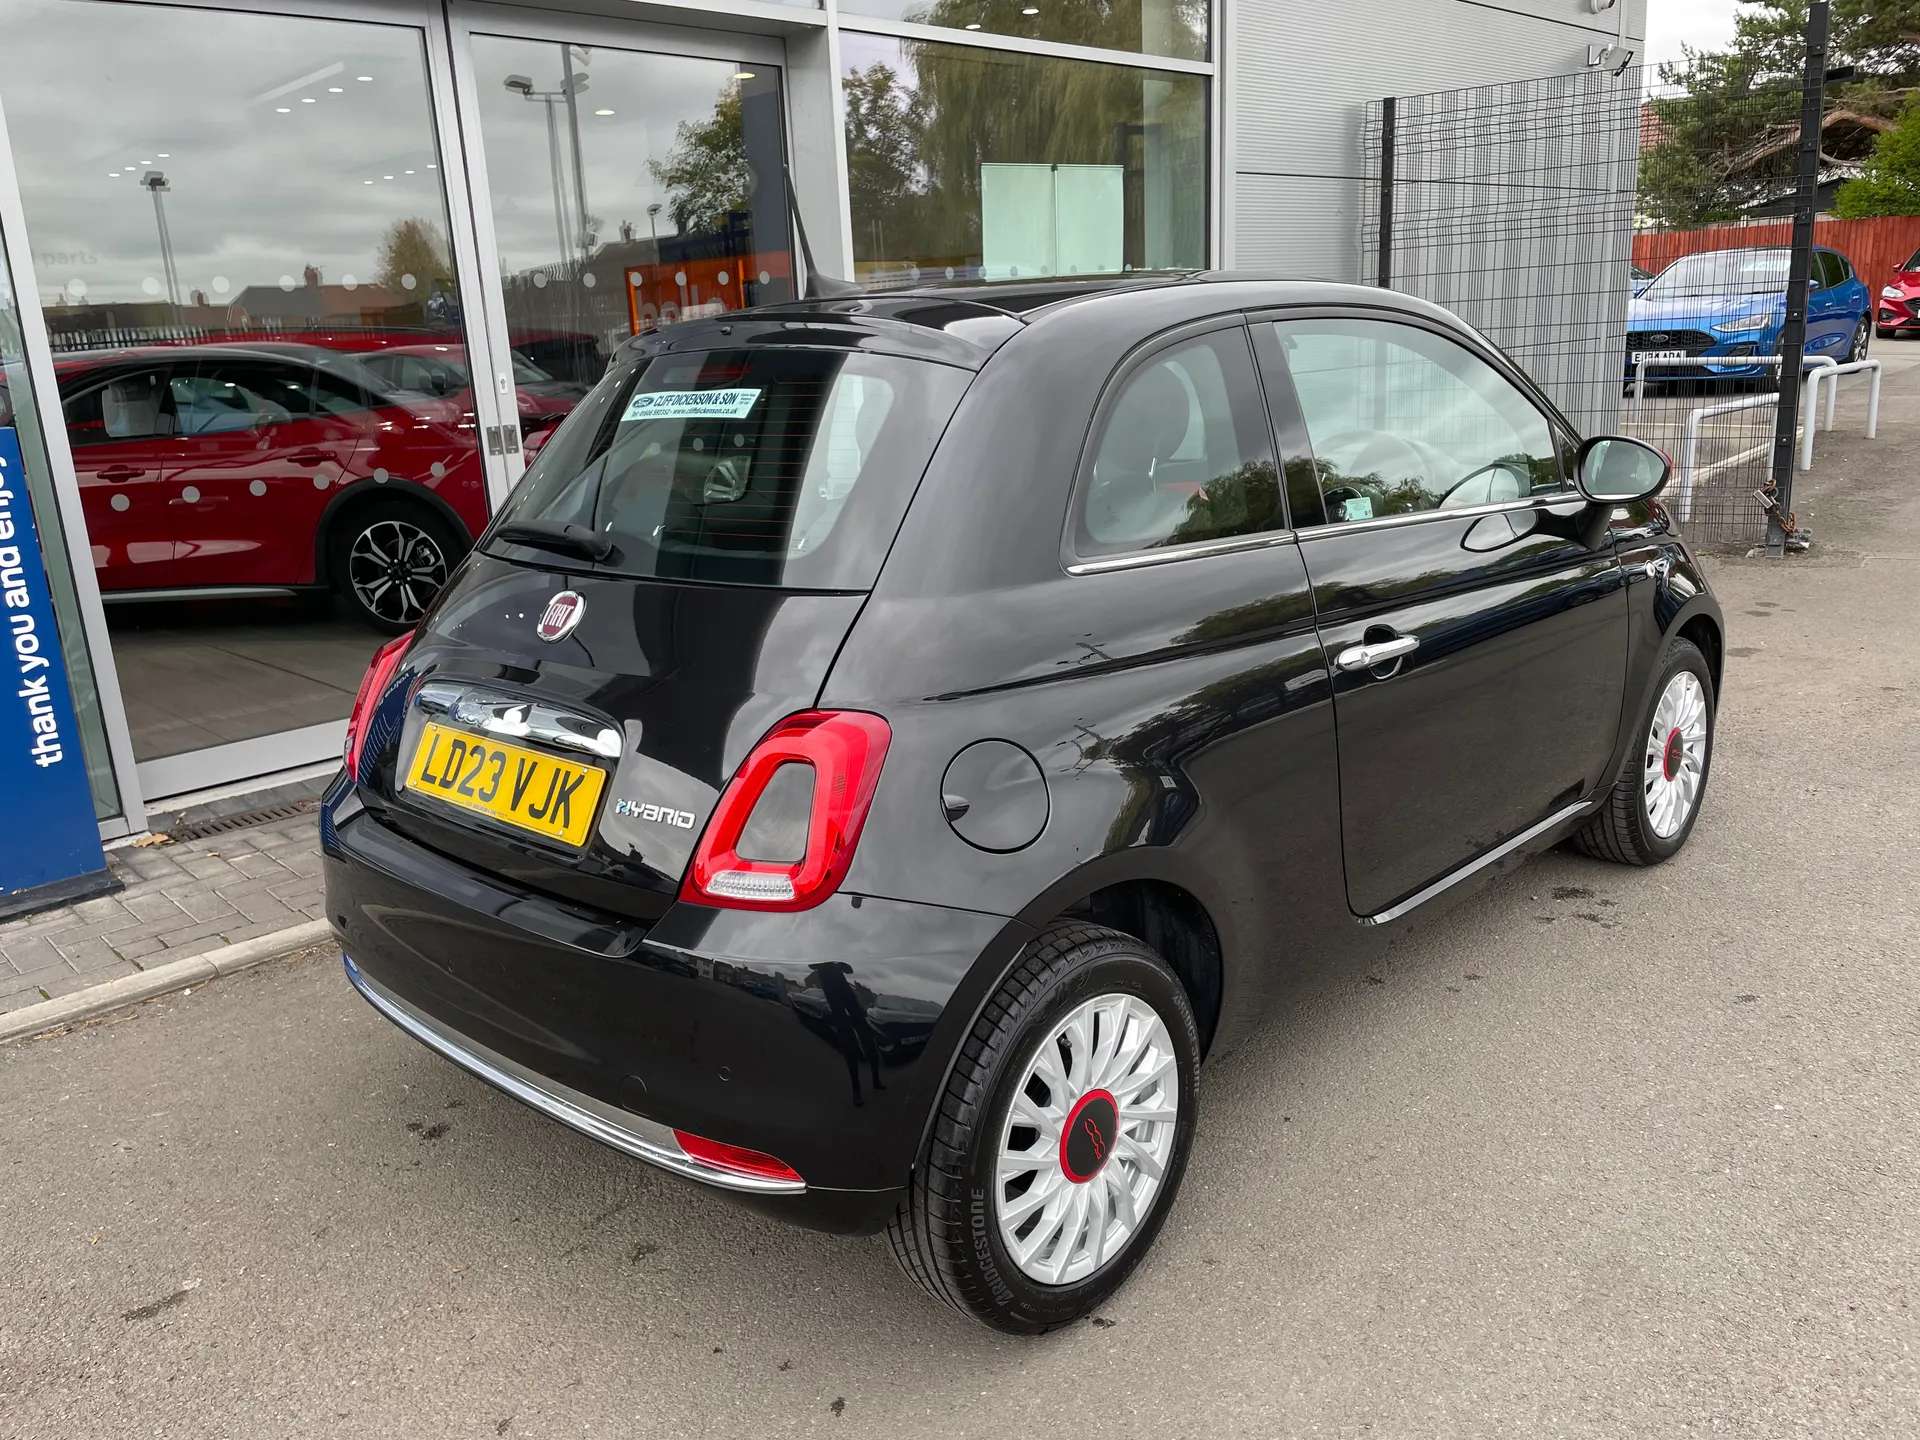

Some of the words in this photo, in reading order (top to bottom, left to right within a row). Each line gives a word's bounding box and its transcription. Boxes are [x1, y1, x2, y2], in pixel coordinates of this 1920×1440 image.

[653, 395, 673, 407] CLIFF
[671, 393, 715, 407] DICKENSON
[711, 393, 722, 405] &
[718, 392, 740, 405] SON
[0, 544, 30, 609] and
[10, 614, 50, 674] you
[544, 603, 575, 628] FIAT
[18, 674, 63, 768] thank
[420, 733, 507, 803] LD23
[509, 757, 586, 830] VJK
[615, 798, 697, 830] HYBRID
